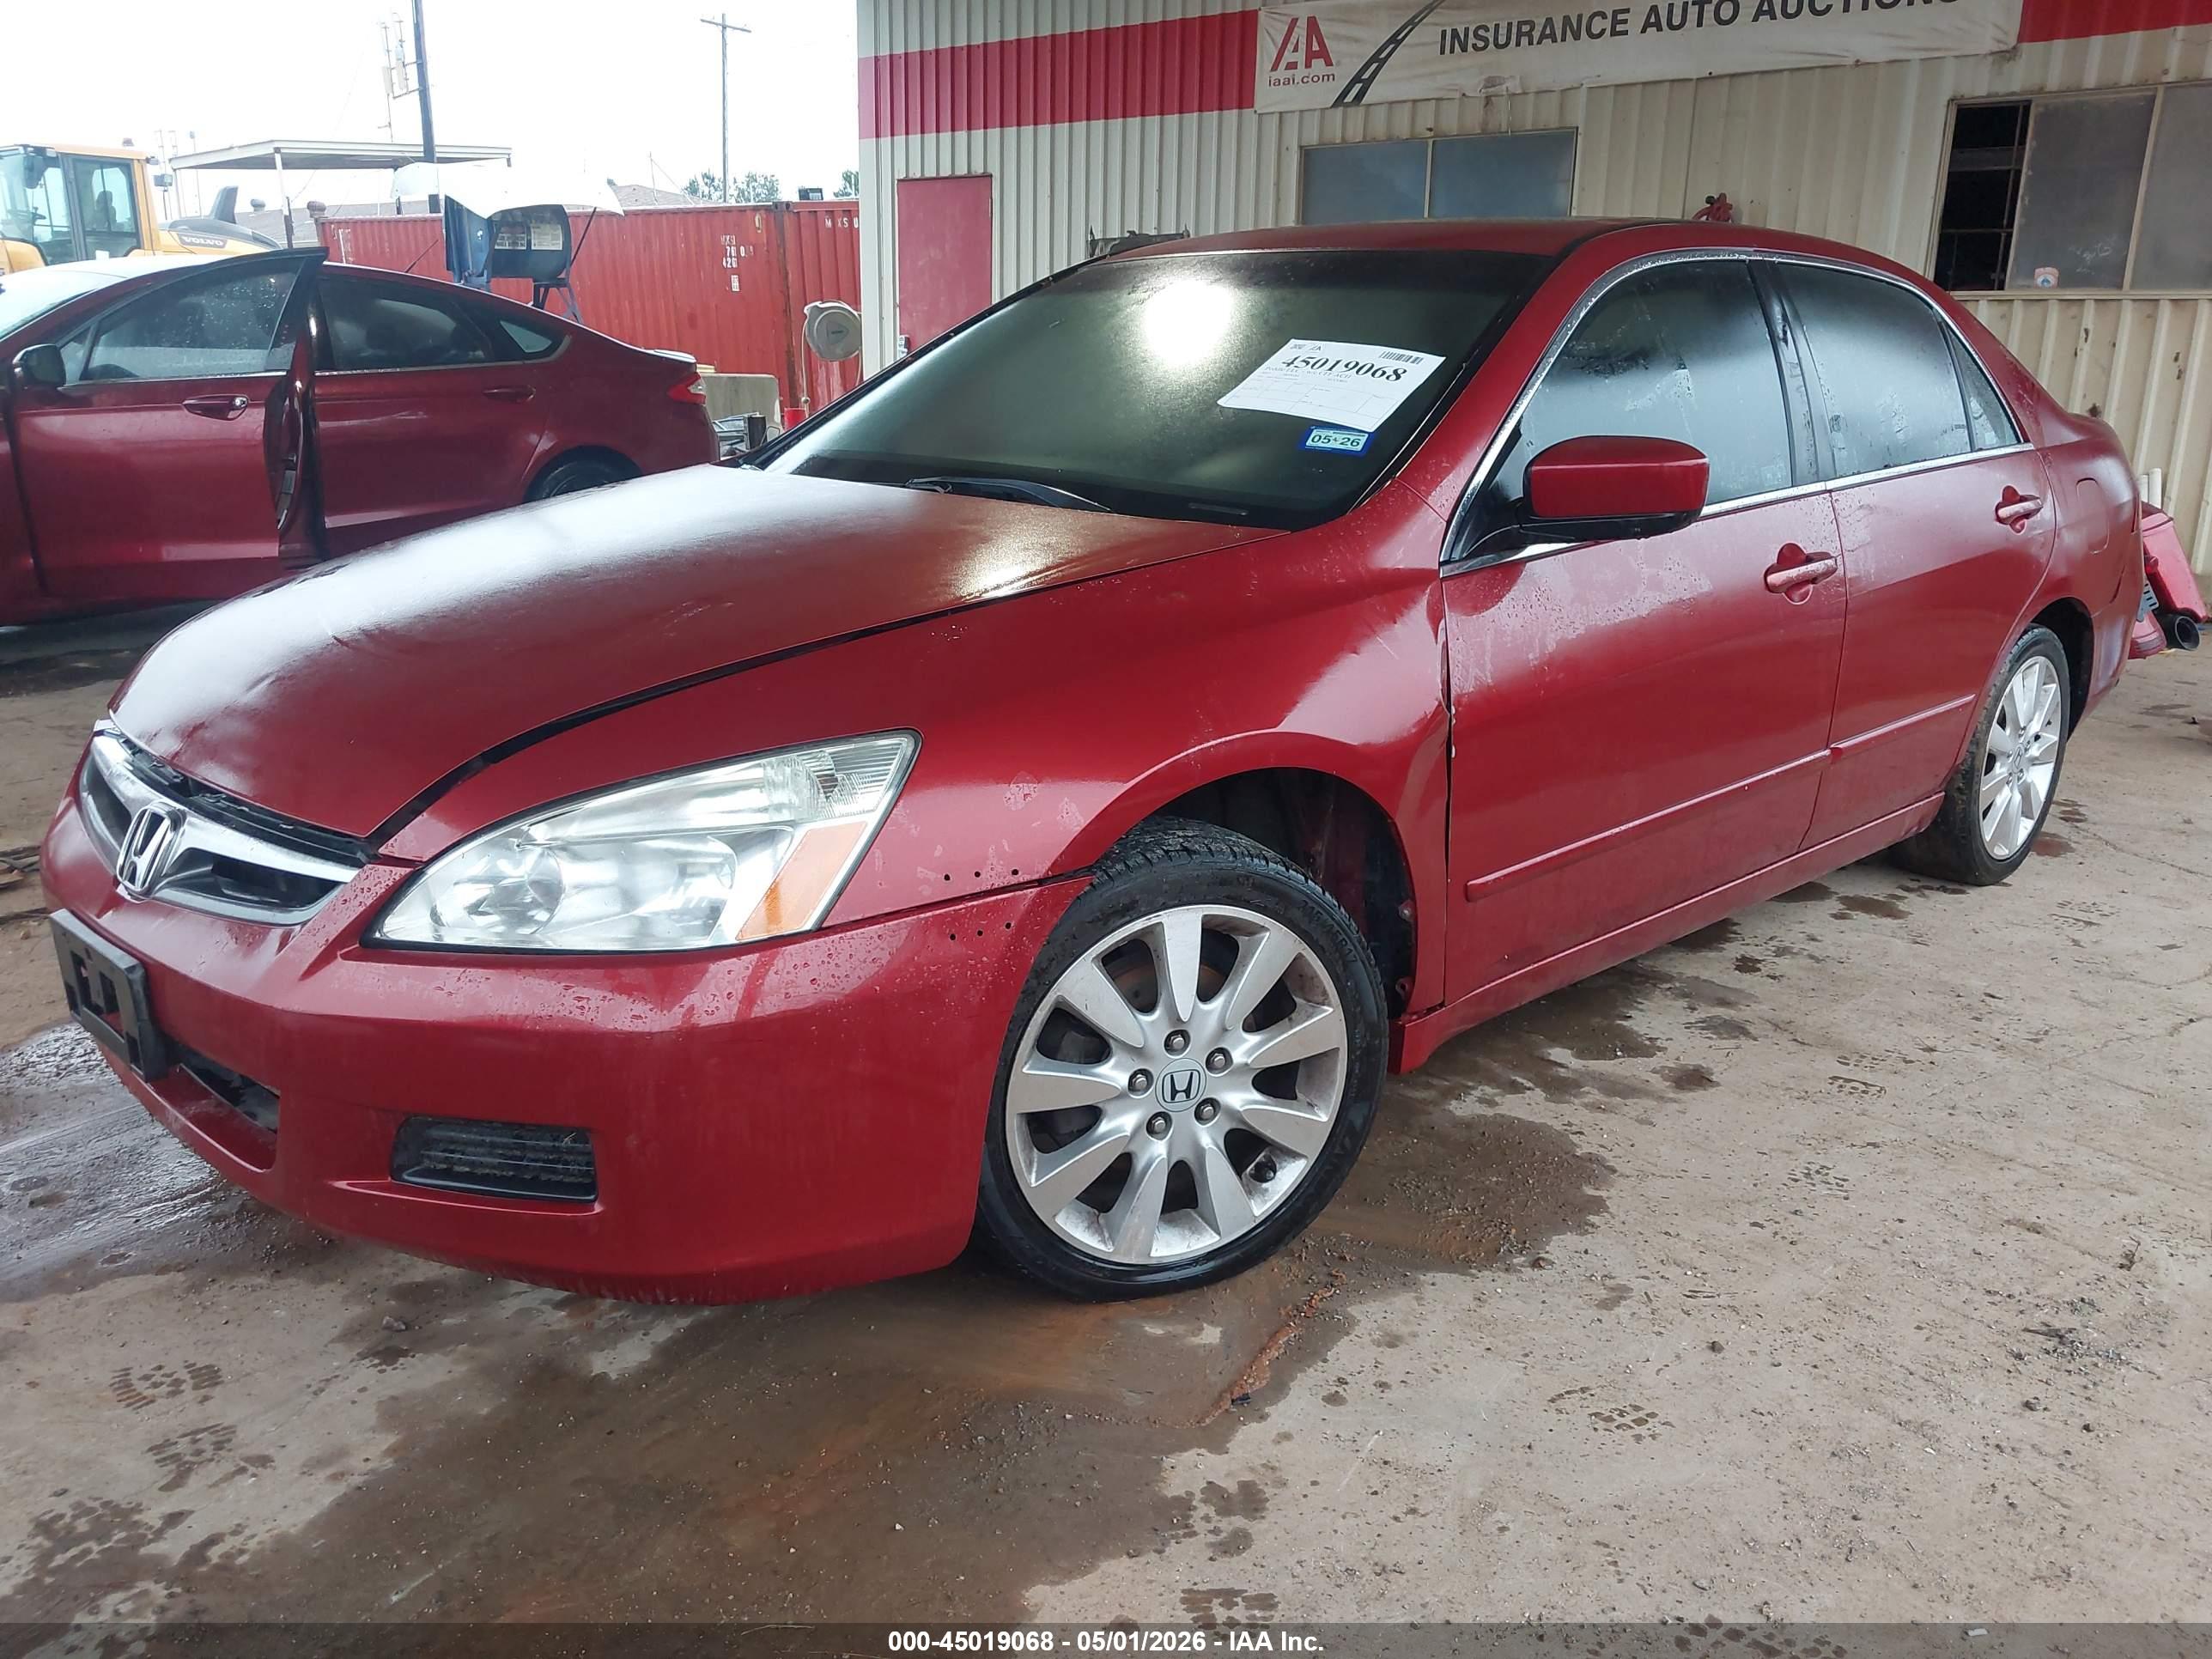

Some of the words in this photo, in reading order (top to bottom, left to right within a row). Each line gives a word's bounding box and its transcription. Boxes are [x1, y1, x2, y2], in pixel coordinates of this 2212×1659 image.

[1439, 8, 1631, 55] INSURANCE
[1640, 0, 1740, 33] AUTO
[1268, 73, 1335, 87] iaai.com
[181, 236, 224, 246] VOLVO
[1282, 356, 1407, 381] 45019068
[1310, 434, 1333, 444] 05
[1340, 437, 1361, 447] 26
